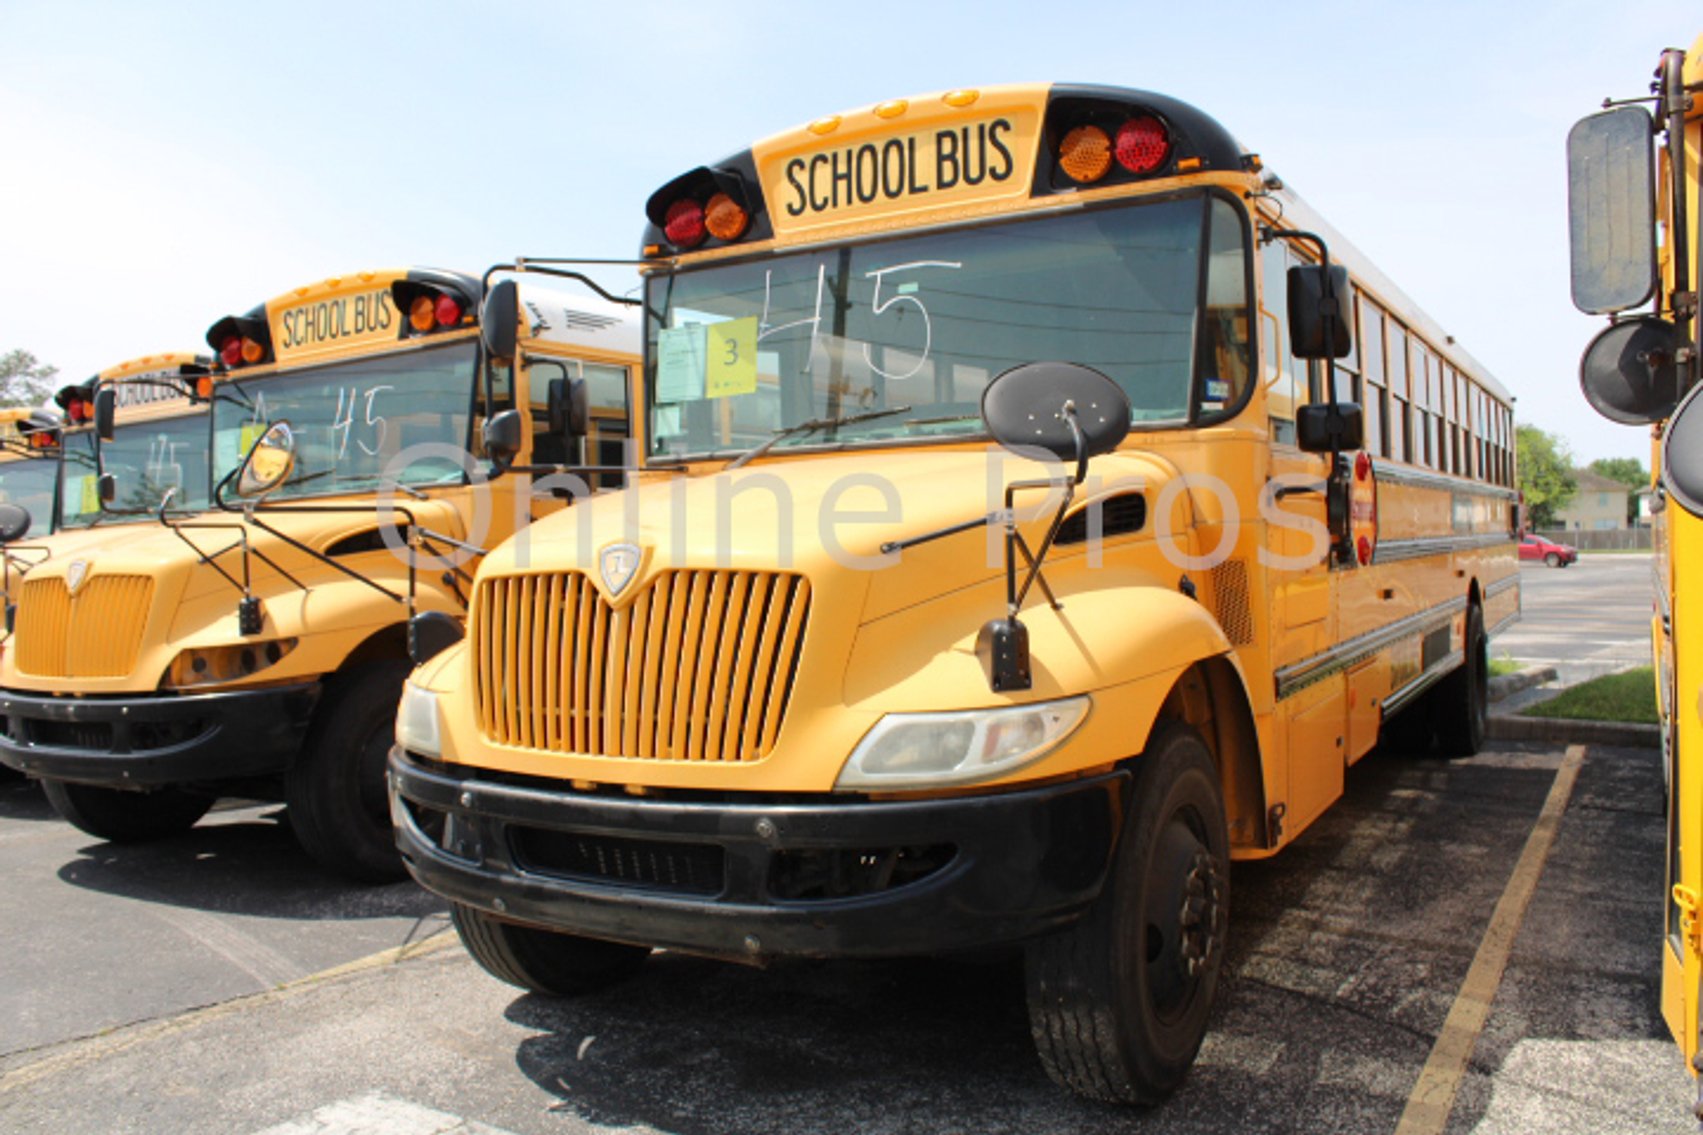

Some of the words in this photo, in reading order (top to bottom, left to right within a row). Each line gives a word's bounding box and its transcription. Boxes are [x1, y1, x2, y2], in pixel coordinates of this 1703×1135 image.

[786, 137, 929, 217] SCHOOL
[936, 118, 1013, 190] BUS
[283, 299, 351, 349] SCHOOL
[354, 288, 392, 334] BUS
[723, 338, 738, 366] 3
[757, 260, 962, 380] 45
[333, 386, 394, 460] 45
